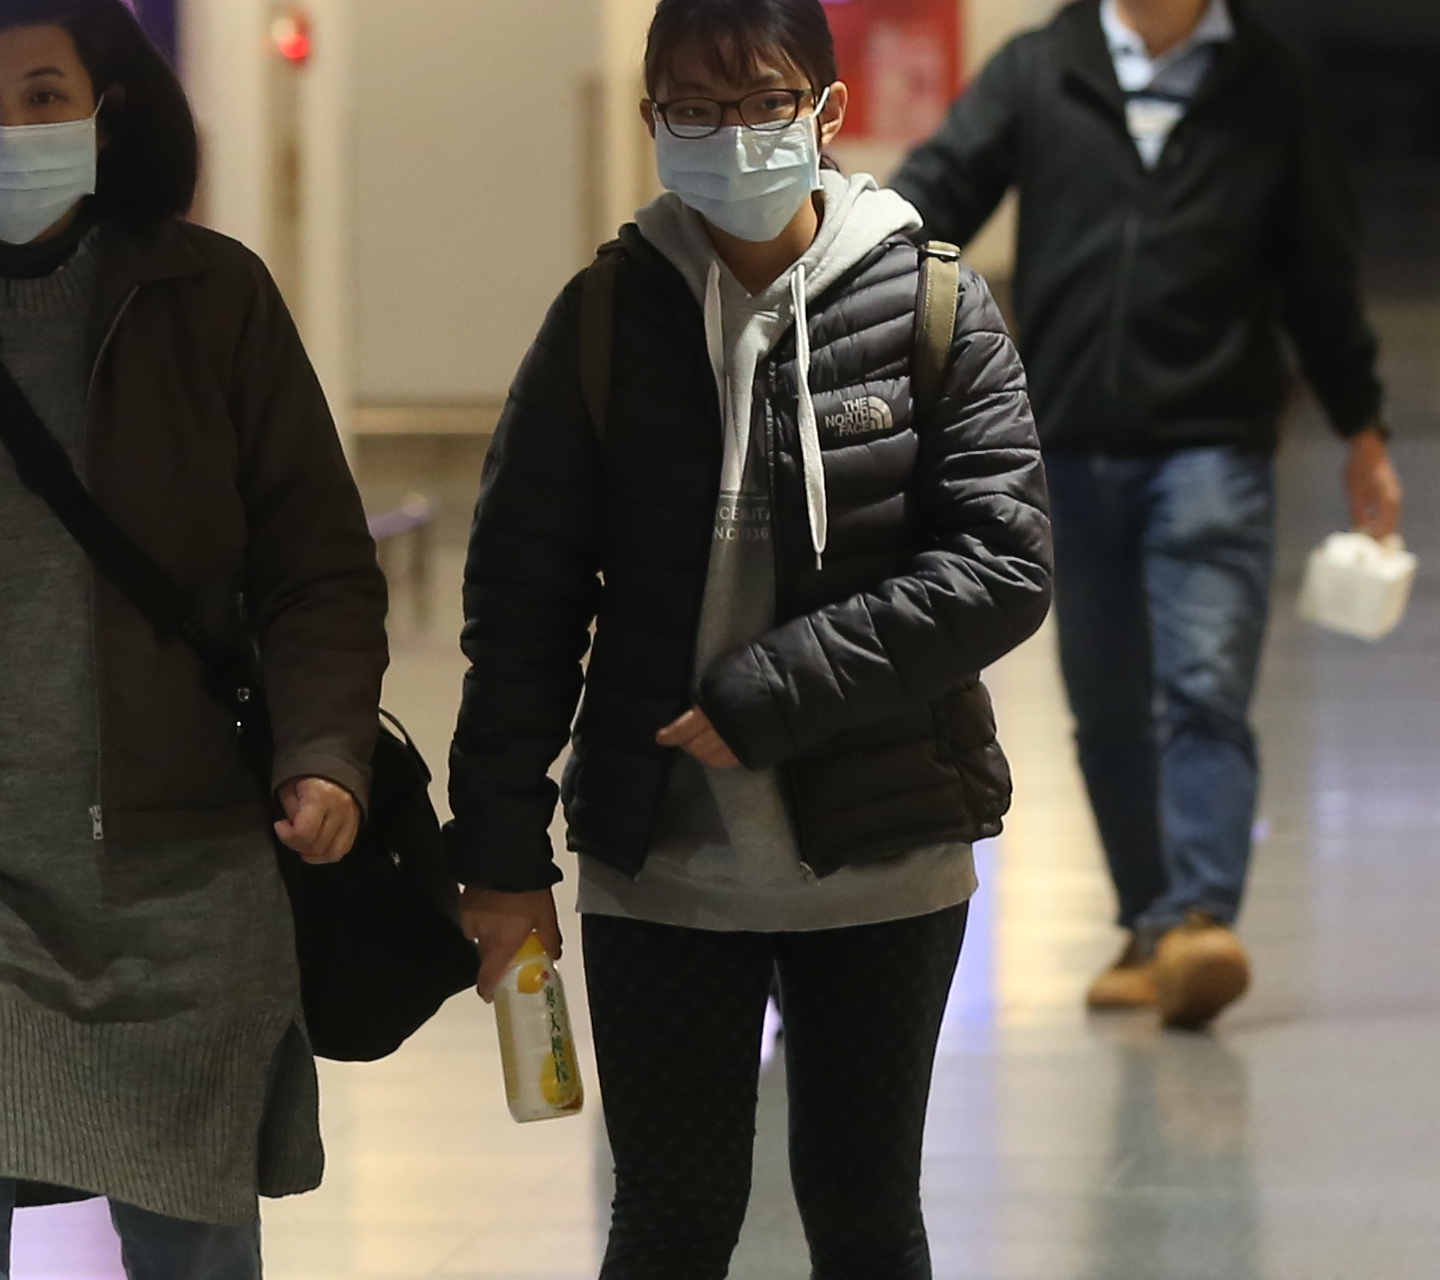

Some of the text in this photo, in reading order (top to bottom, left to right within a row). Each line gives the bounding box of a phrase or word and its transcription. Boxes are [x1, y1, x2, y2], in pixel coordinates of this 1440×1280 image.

[842, 396, 867, 413] THE
[825, 405, 869, 428] NORTH
[839, 421, 869, 437] FACE
